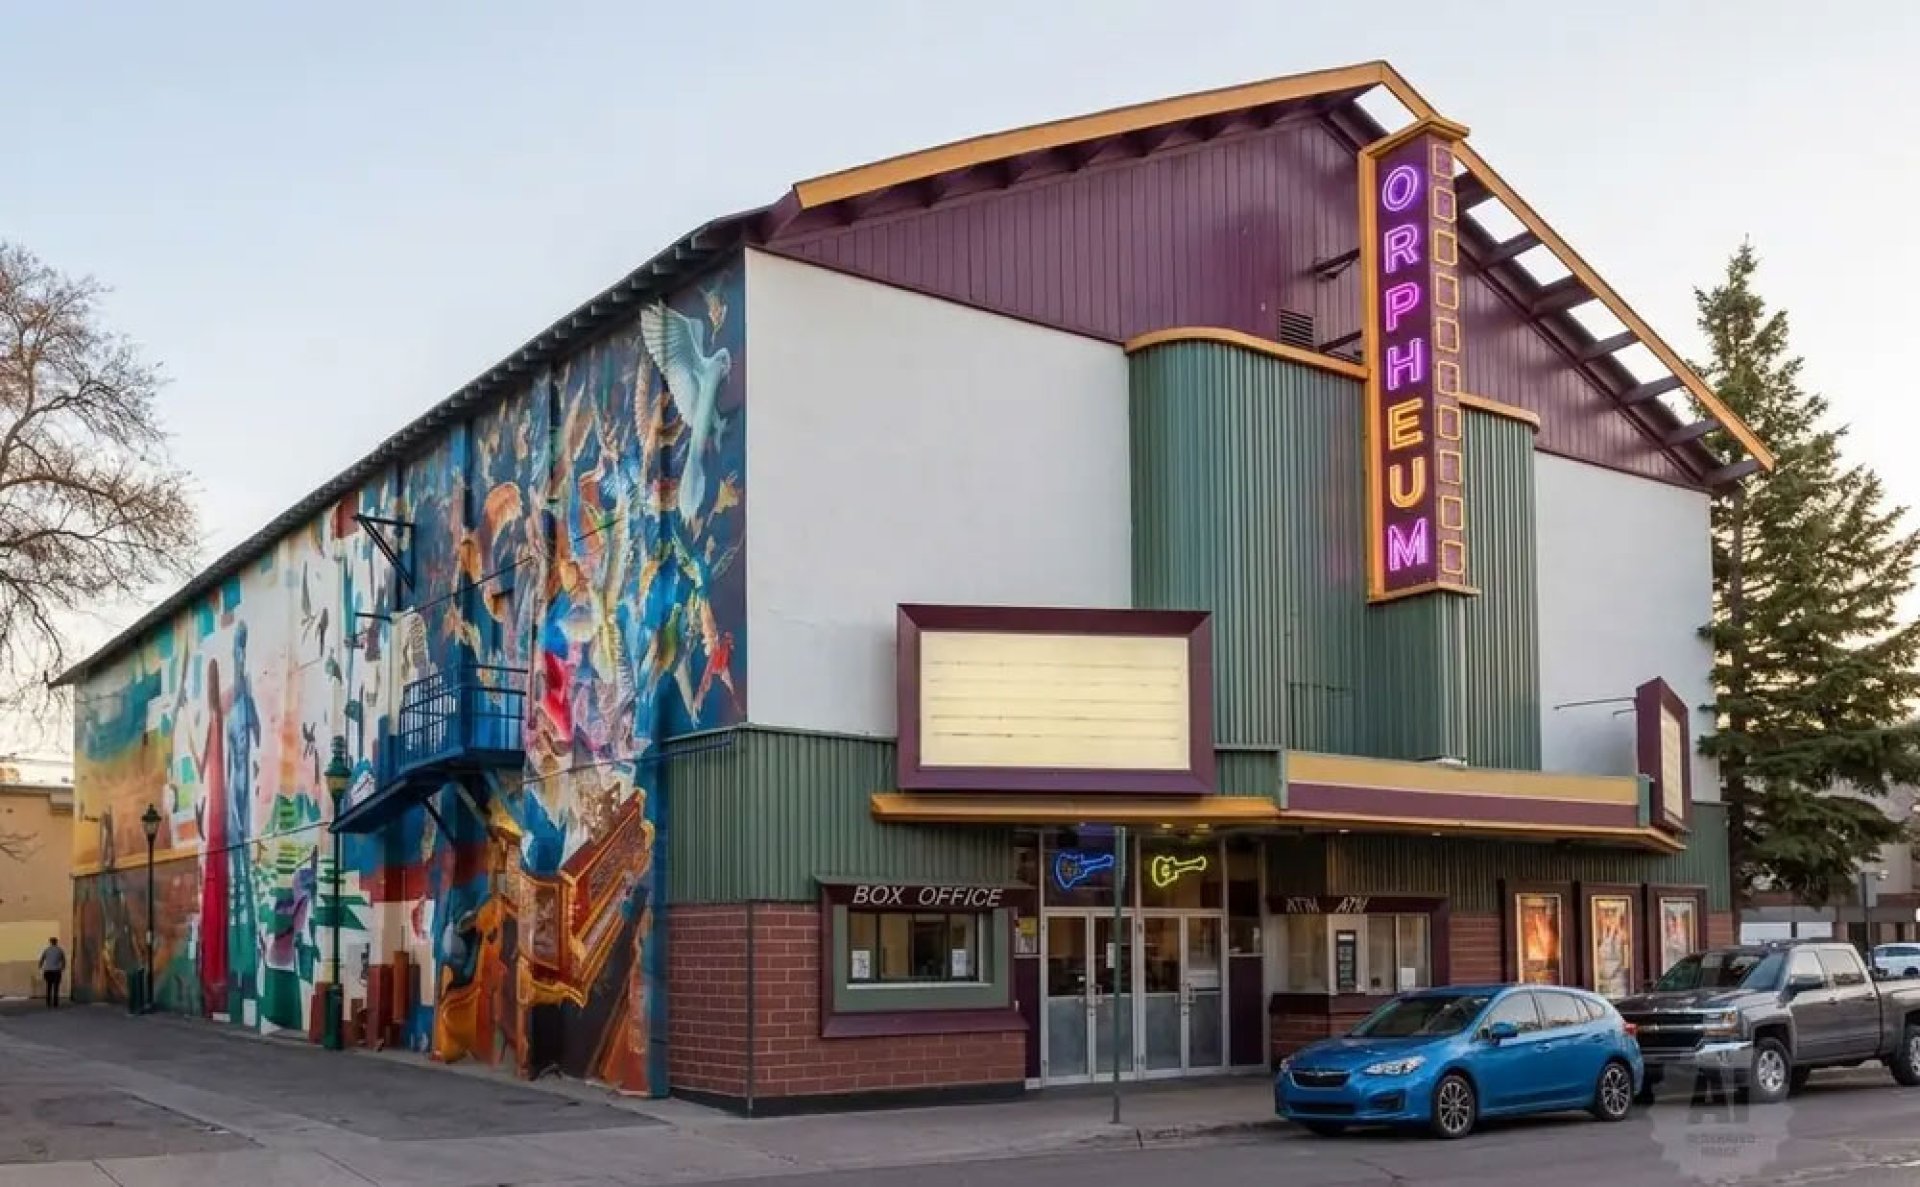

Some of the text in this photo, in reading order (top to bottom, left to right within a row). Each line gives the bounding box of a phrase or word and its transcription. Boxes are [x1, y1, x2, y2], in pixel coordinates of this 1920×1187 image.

[1382, 164, 1429, 571] ORPHEUM
[852, 885, 1003, 907] BOX OFFICE
